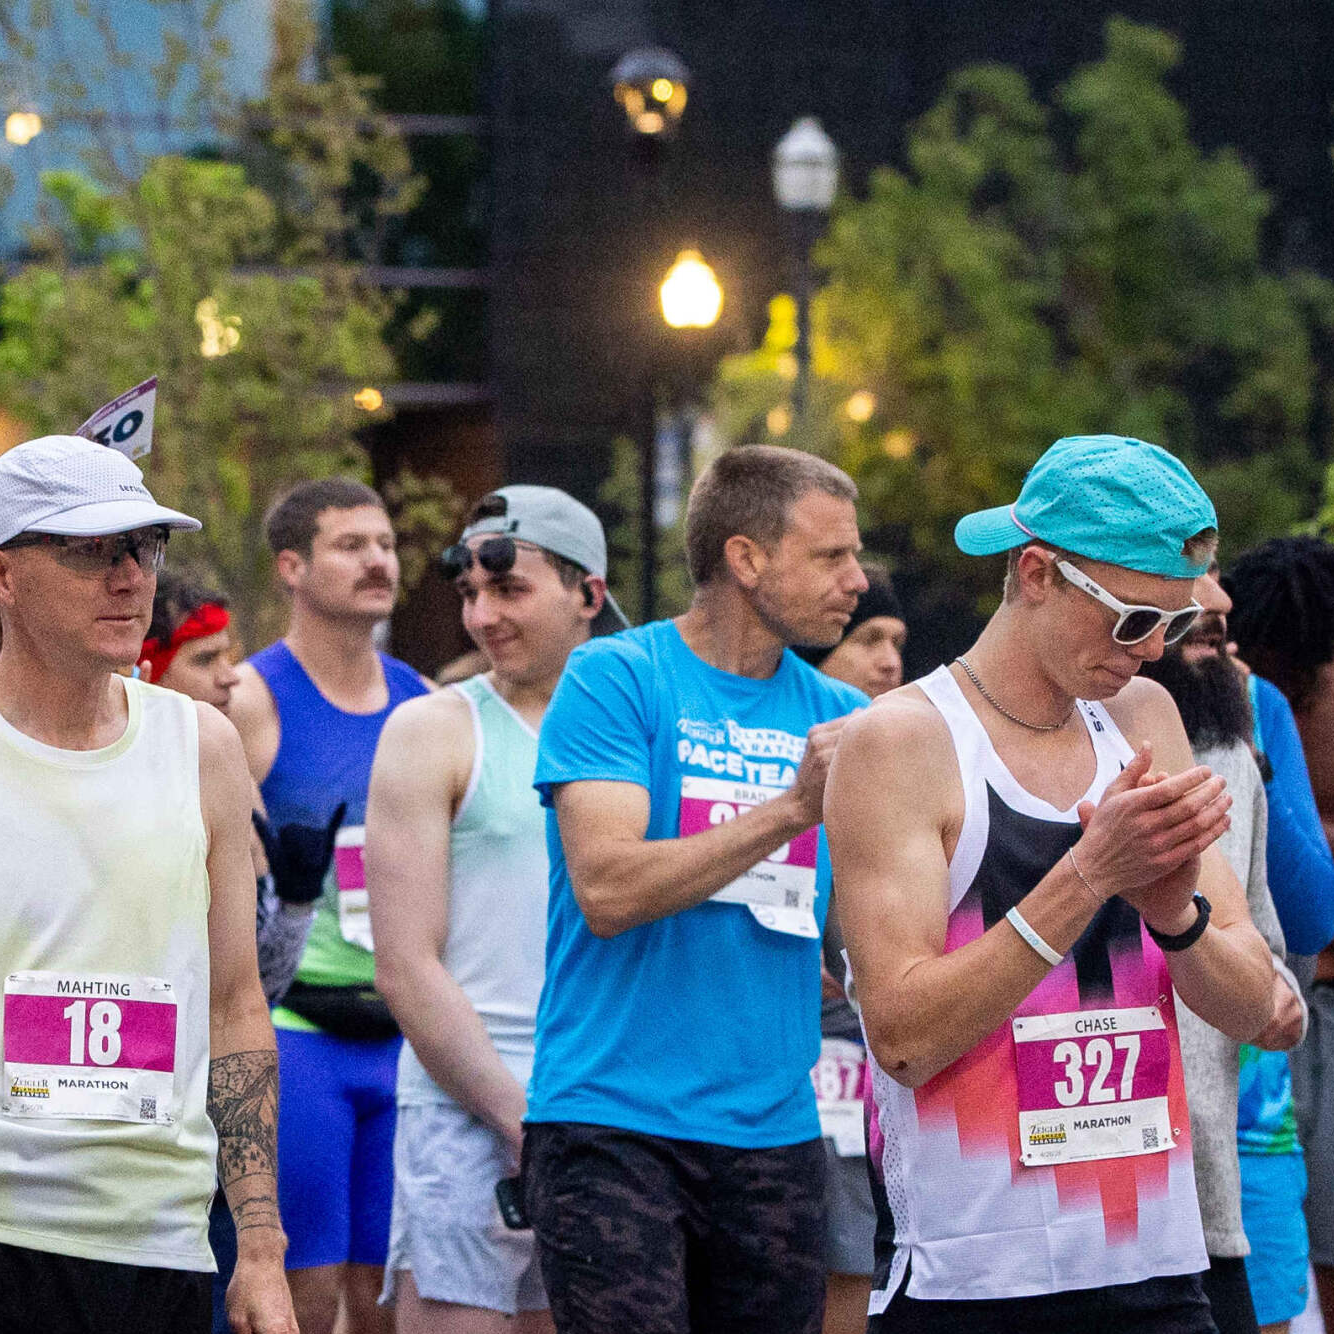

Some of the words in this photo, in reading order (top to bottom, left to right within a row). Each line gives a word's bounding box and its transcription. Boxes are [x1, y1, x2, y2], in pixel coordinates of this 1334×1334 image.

[677, 739, 743, 777] PACE
[744, 760, 797, 786] TEA
[734, 788, 767, 803] BRAD
[57, 980, 131, 996] MAHTING
[63, 1000, 123, 1066] 18
[1075, 1017, 1117, 1034] CHASE
[1053, 1034, 1141, 1107] 327
[58, 1078, 129, 1090] MARATHON
[1073, 1115, 1131, 1130] MARATHON
